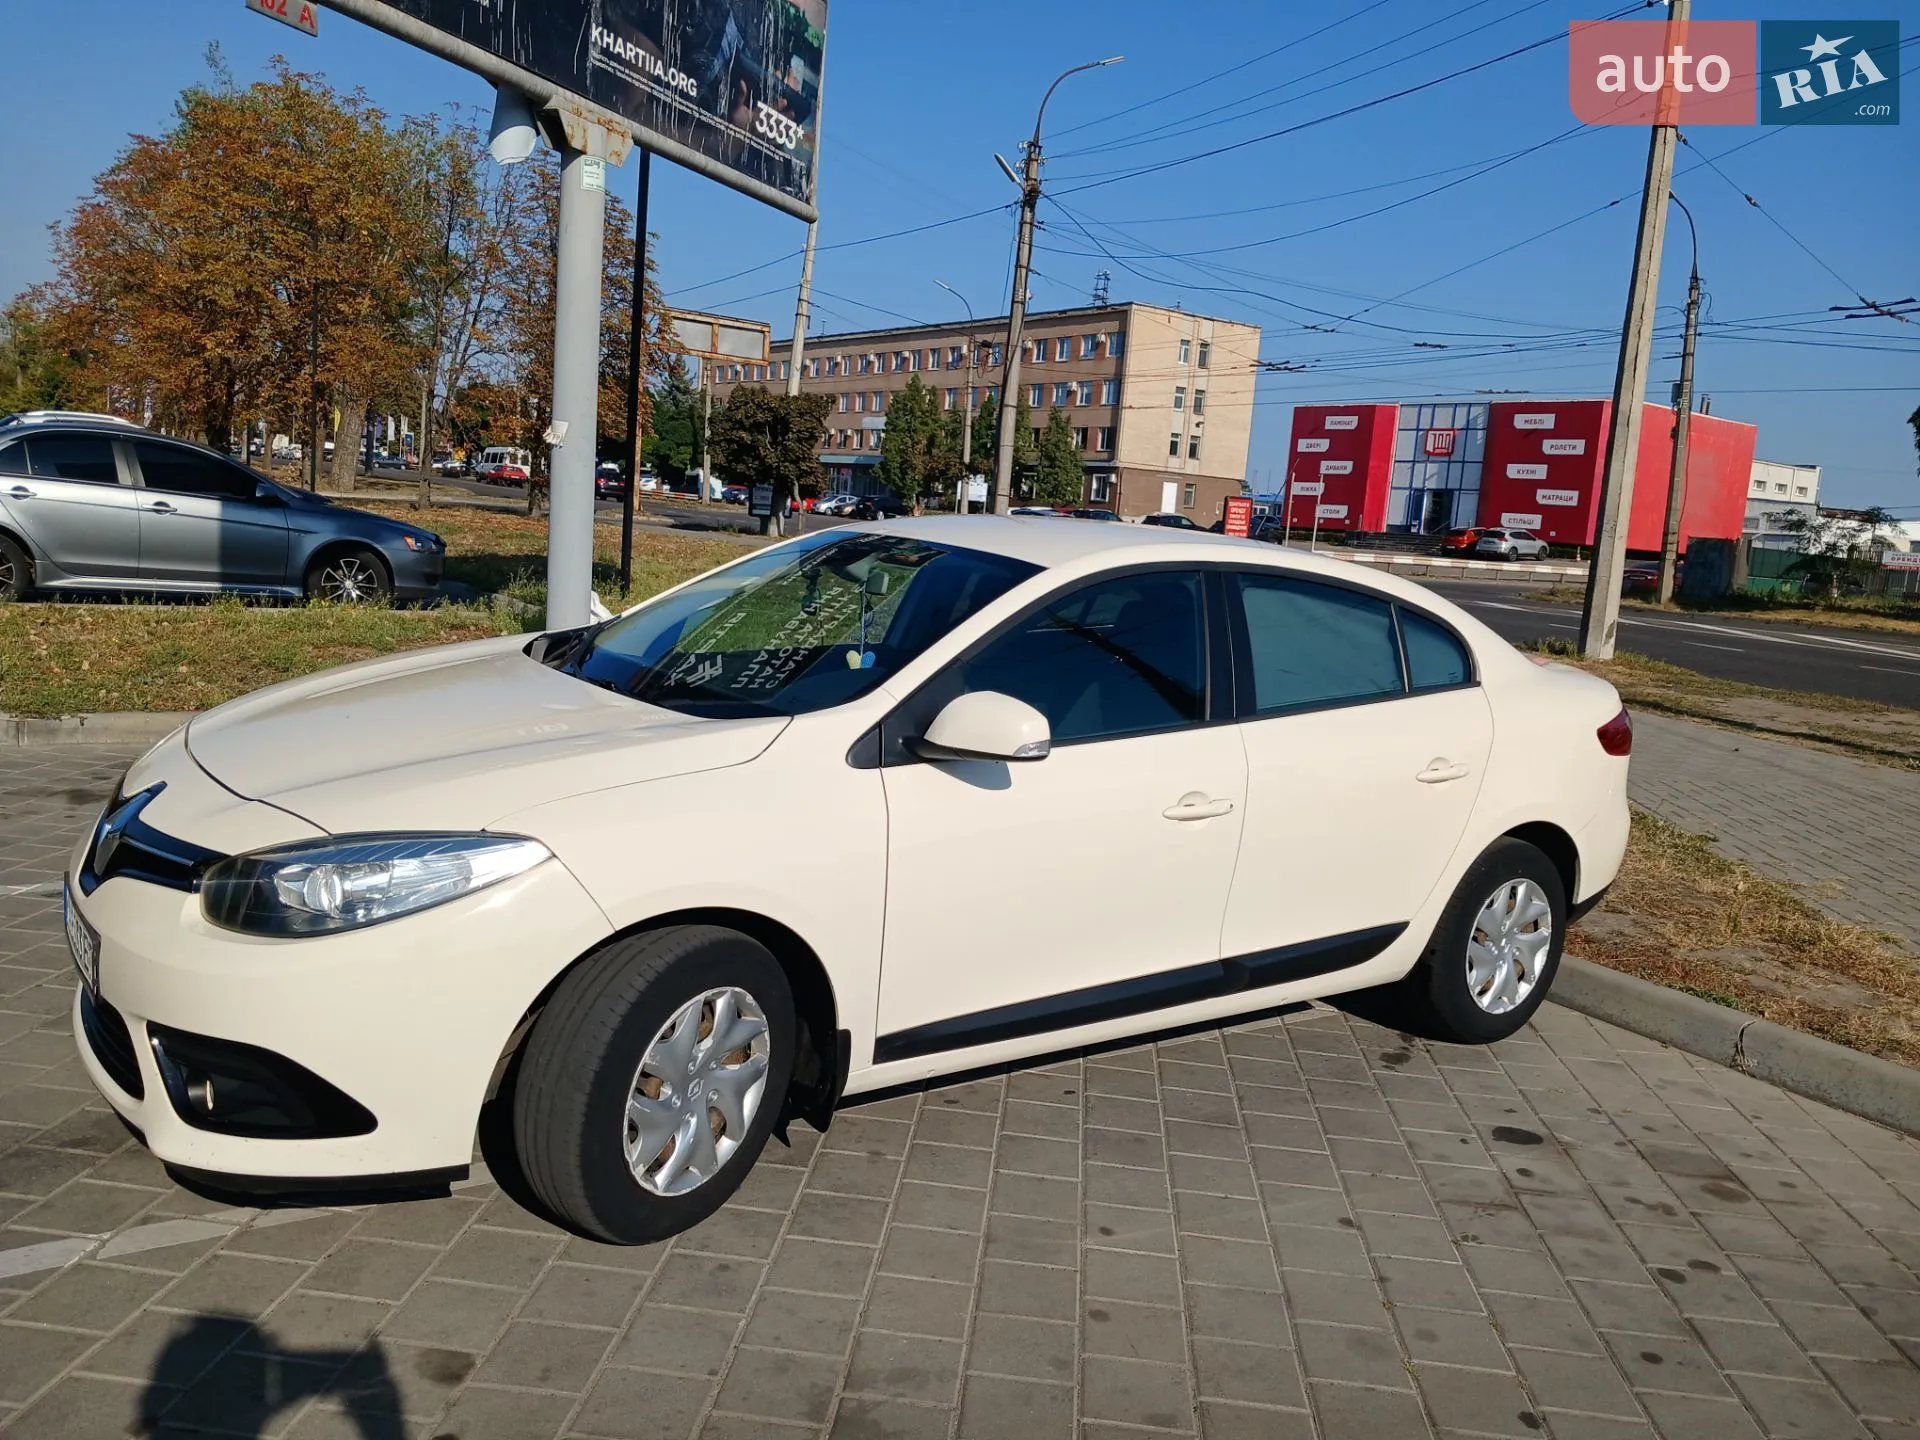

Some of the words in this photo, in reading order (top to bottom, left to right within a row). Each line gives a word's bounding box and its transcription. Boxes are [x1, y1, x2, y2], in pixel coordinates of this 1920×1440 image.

[591, 22, 698, 98] KHARTIIA.ORG
[1549, 443, 1578, 451] РОЛЕТИ
[1541, 494, 1575, 502] МАТРАЦИ
[1322, 507, 1341, 515] СТОЛИ
[1507, 517, 1535, 526] СТІЛЬЦІ
